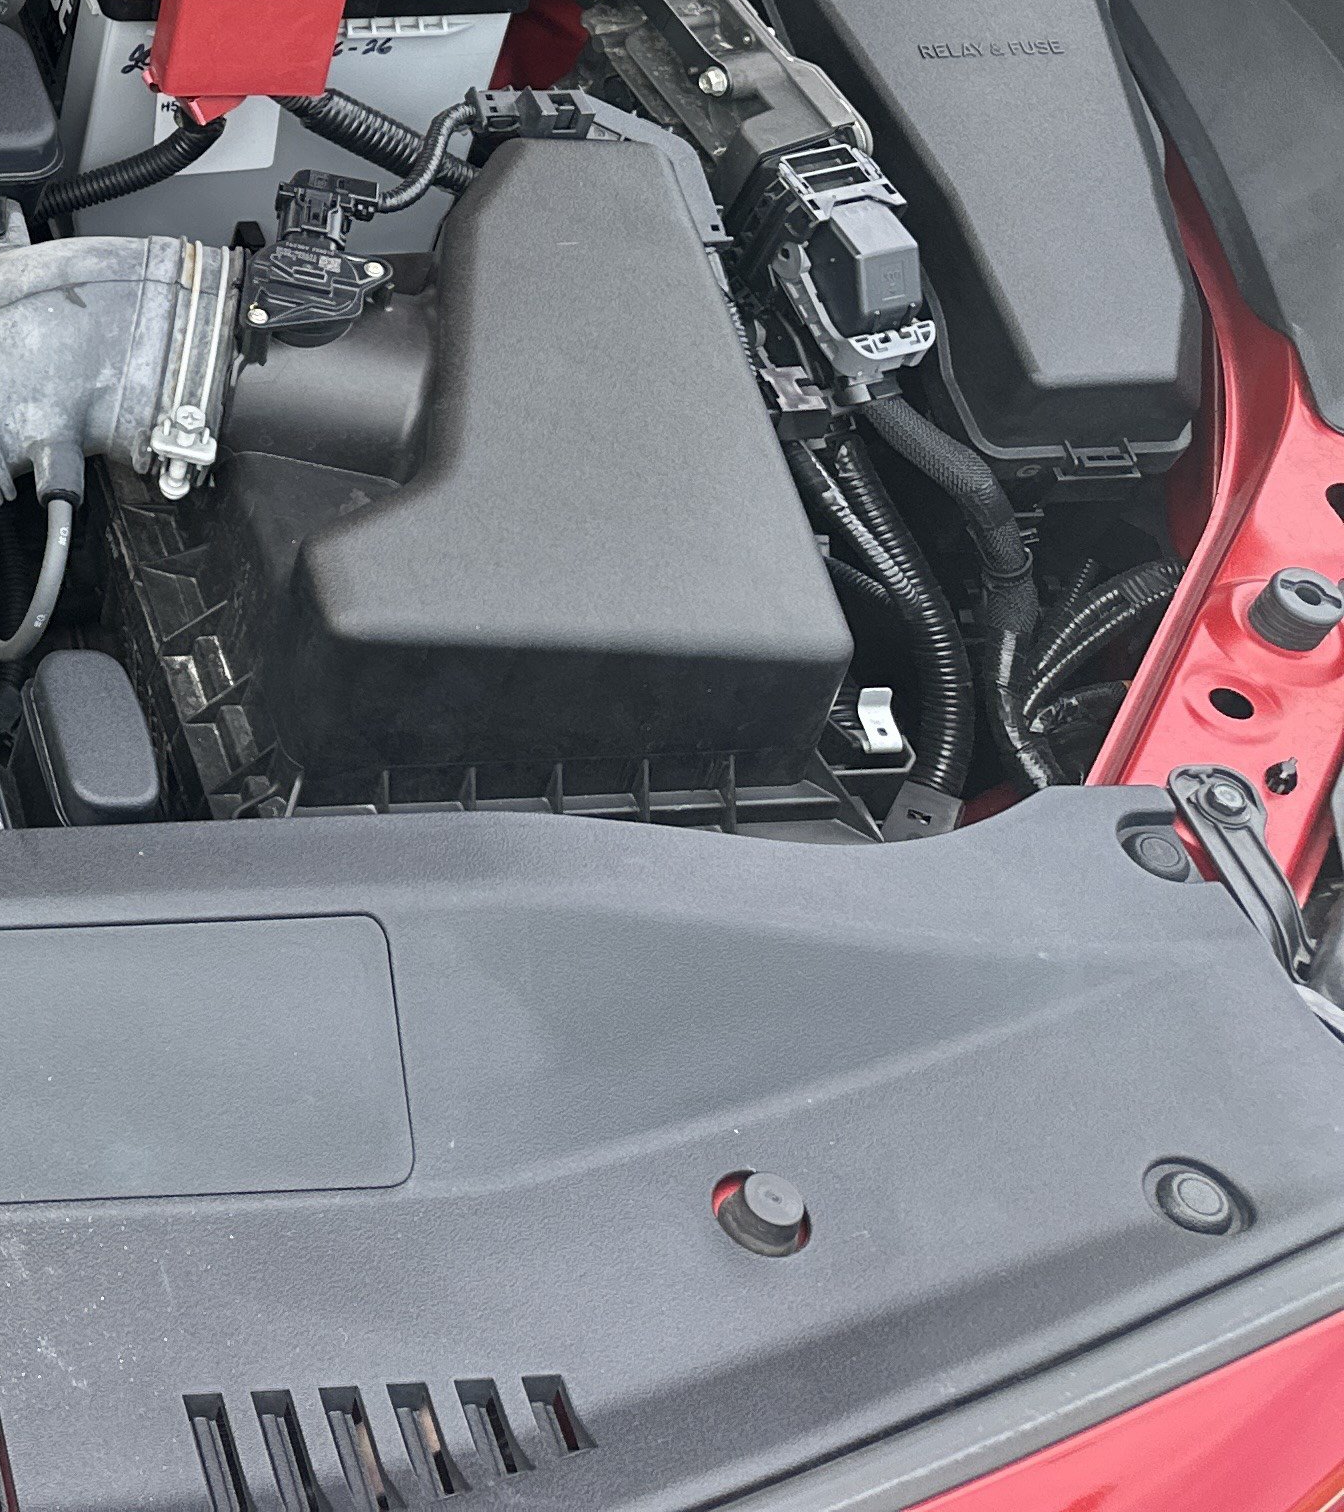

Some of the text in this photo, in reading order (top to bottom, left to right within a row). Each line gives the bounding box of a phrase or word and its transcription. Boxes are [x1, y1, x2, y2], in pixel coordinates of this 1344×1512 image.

[917, 39, 1065, 60] RELAY & FUSE
